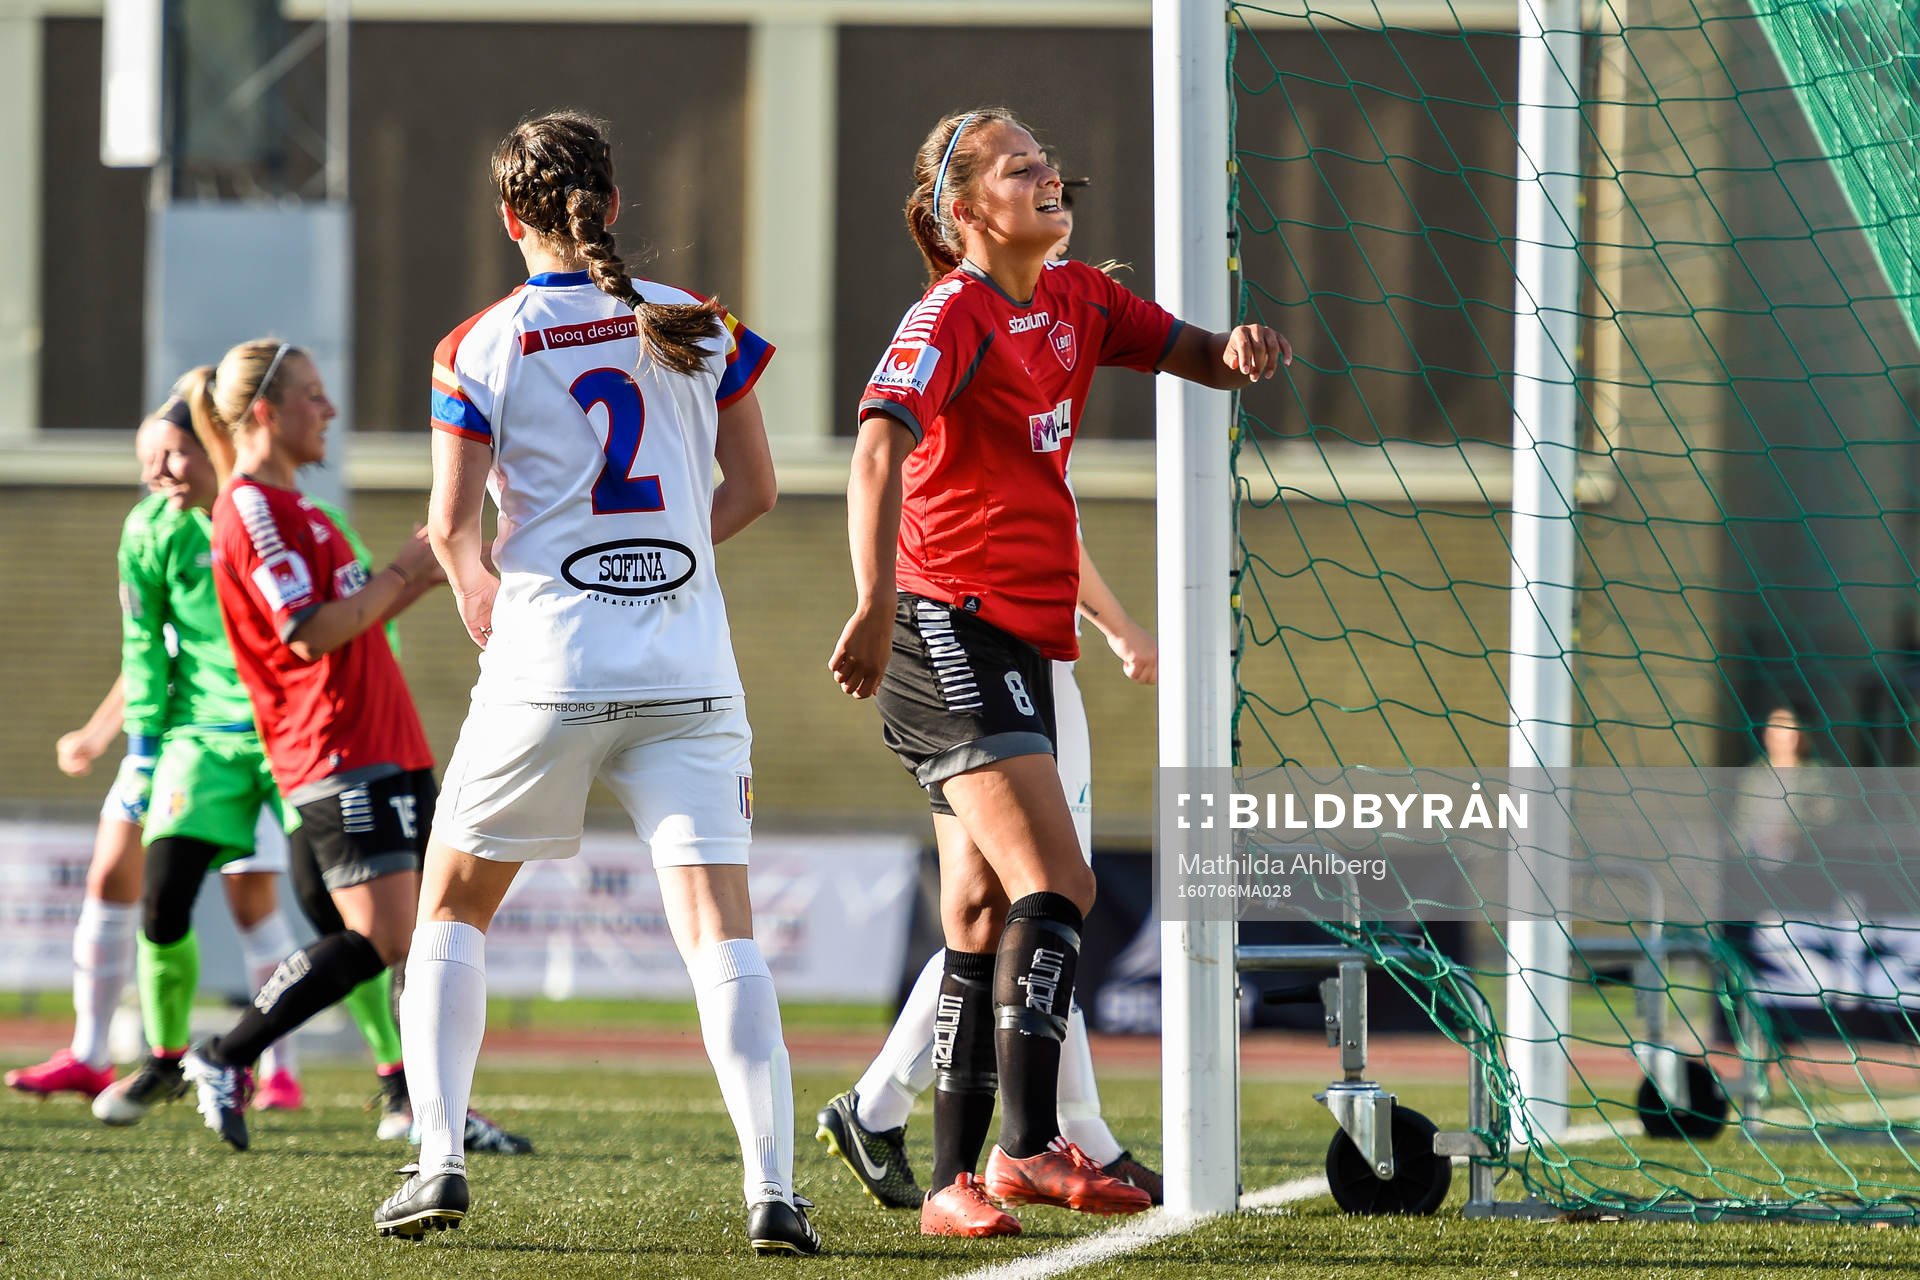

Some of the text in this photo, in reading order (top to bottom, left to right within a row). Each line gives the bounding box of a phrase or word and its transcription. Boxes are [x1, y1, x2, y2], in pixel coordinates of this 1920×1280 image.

[549, 320, 638, 344] looq design
[873, 374, 903, 384] ENSKA
[568, 366, 666, 516] 2
[598, 551, 667, 583] SOFINA
[1004, 671, 1035, 716] 8
